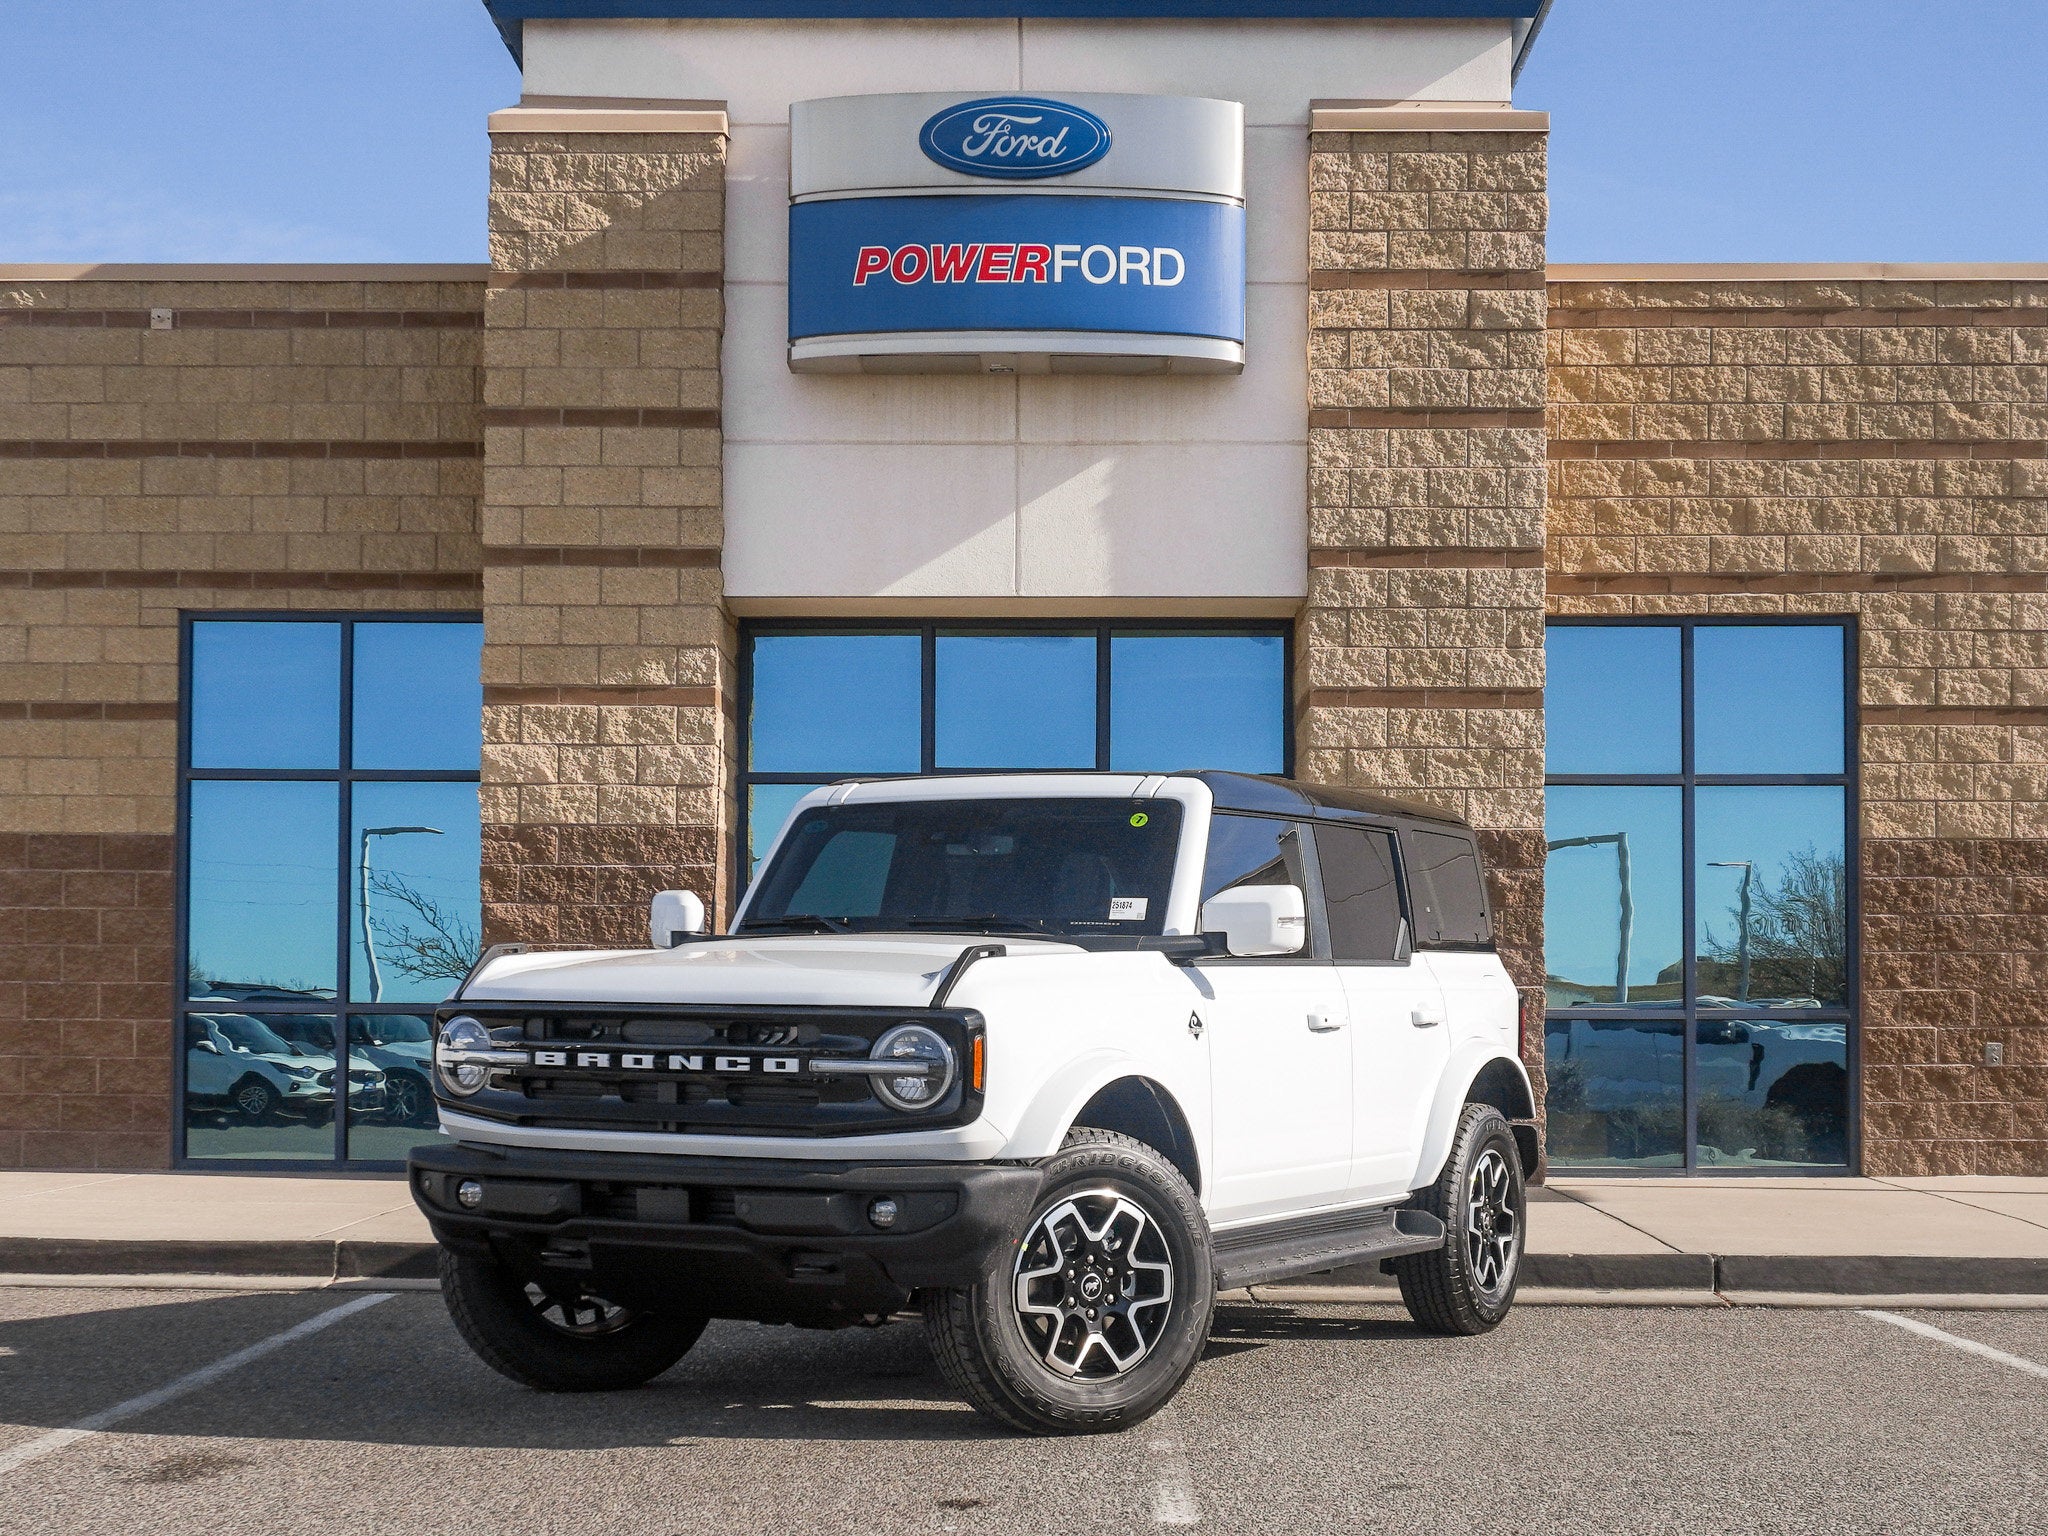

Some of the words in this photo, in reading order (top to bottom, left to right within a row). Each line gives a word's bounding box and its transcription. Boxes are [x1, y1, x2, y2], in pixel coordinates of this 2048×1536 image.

[962, 113, 1070, 159] Ford
[534, 1051, 800, 1073] BRONCO
[1050, 1151, 1205, 1248] BRIDGESTONE
